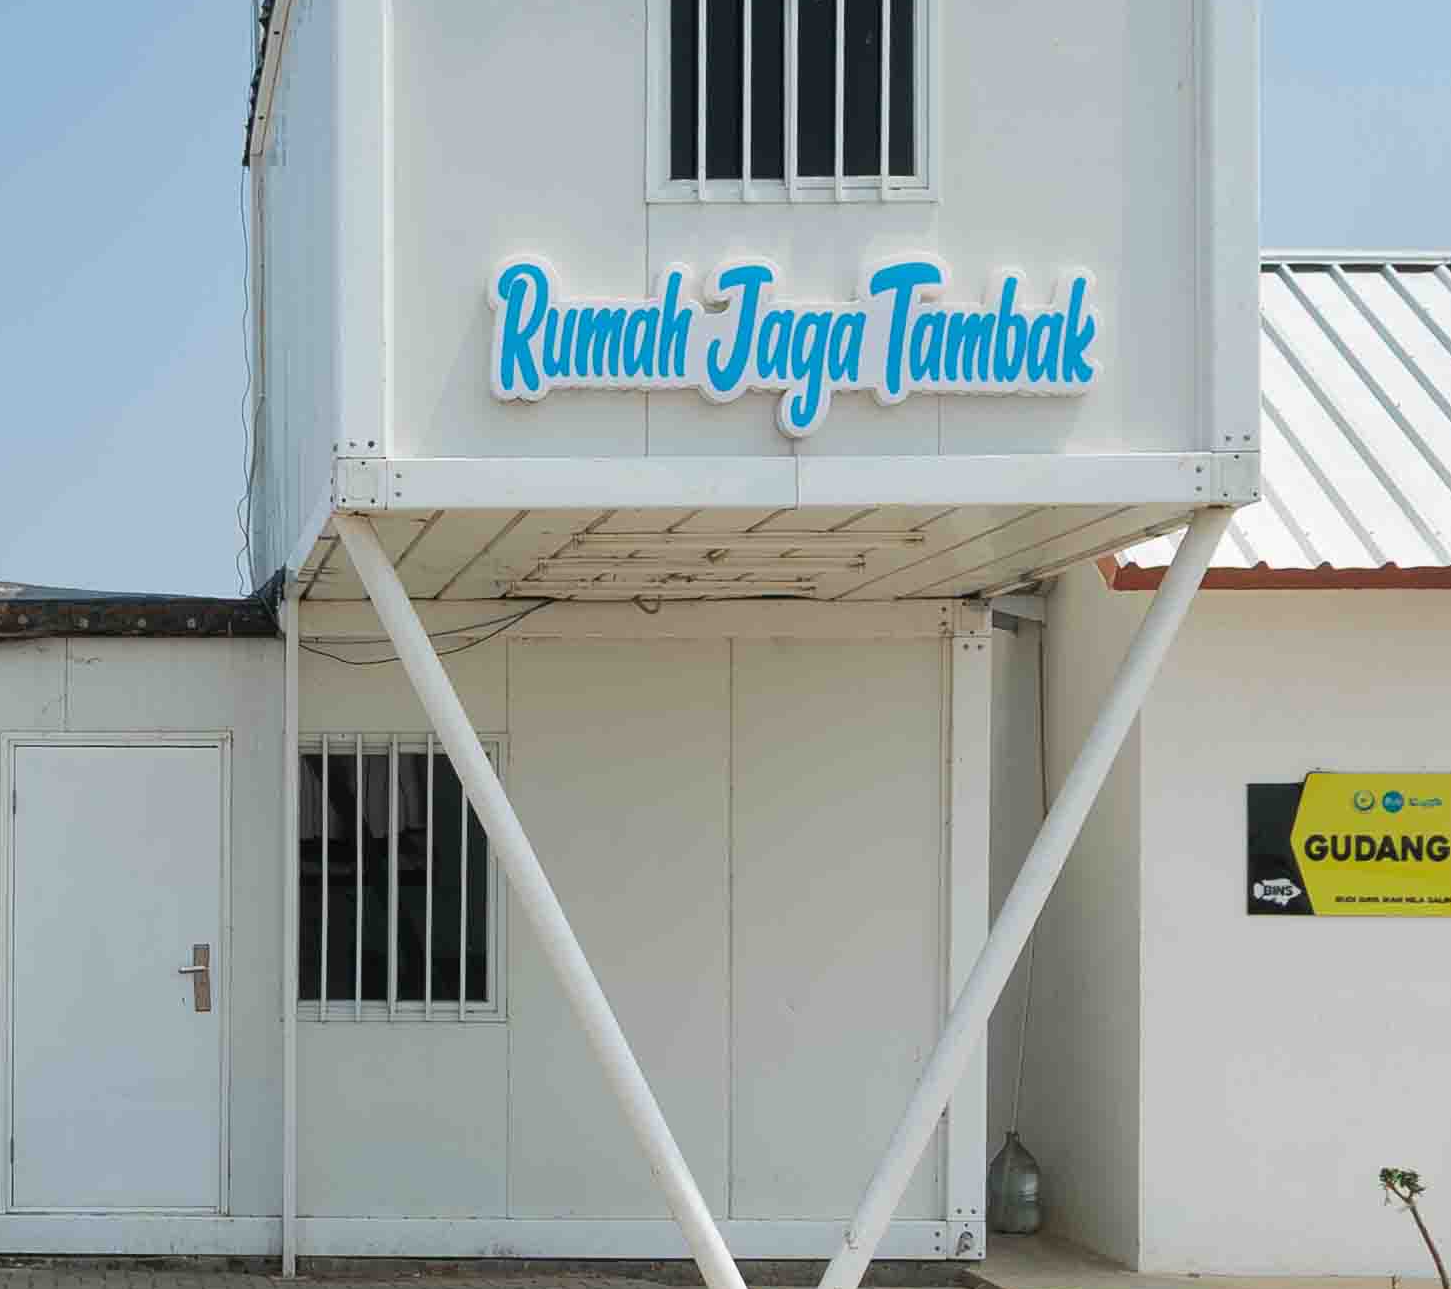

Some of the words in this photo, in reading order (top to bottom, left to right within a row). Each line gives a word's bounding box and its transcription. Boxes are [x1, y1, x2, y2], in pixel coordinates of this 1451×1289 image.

[498, 262, 692, 391] Rumah
[706, 263, 866, 428] Jaga
[870, 261, 1097, 393] Tambak
[1304, 834, 1451, 862] GUDANG
[1264, 885, 1293, 897] BINS
